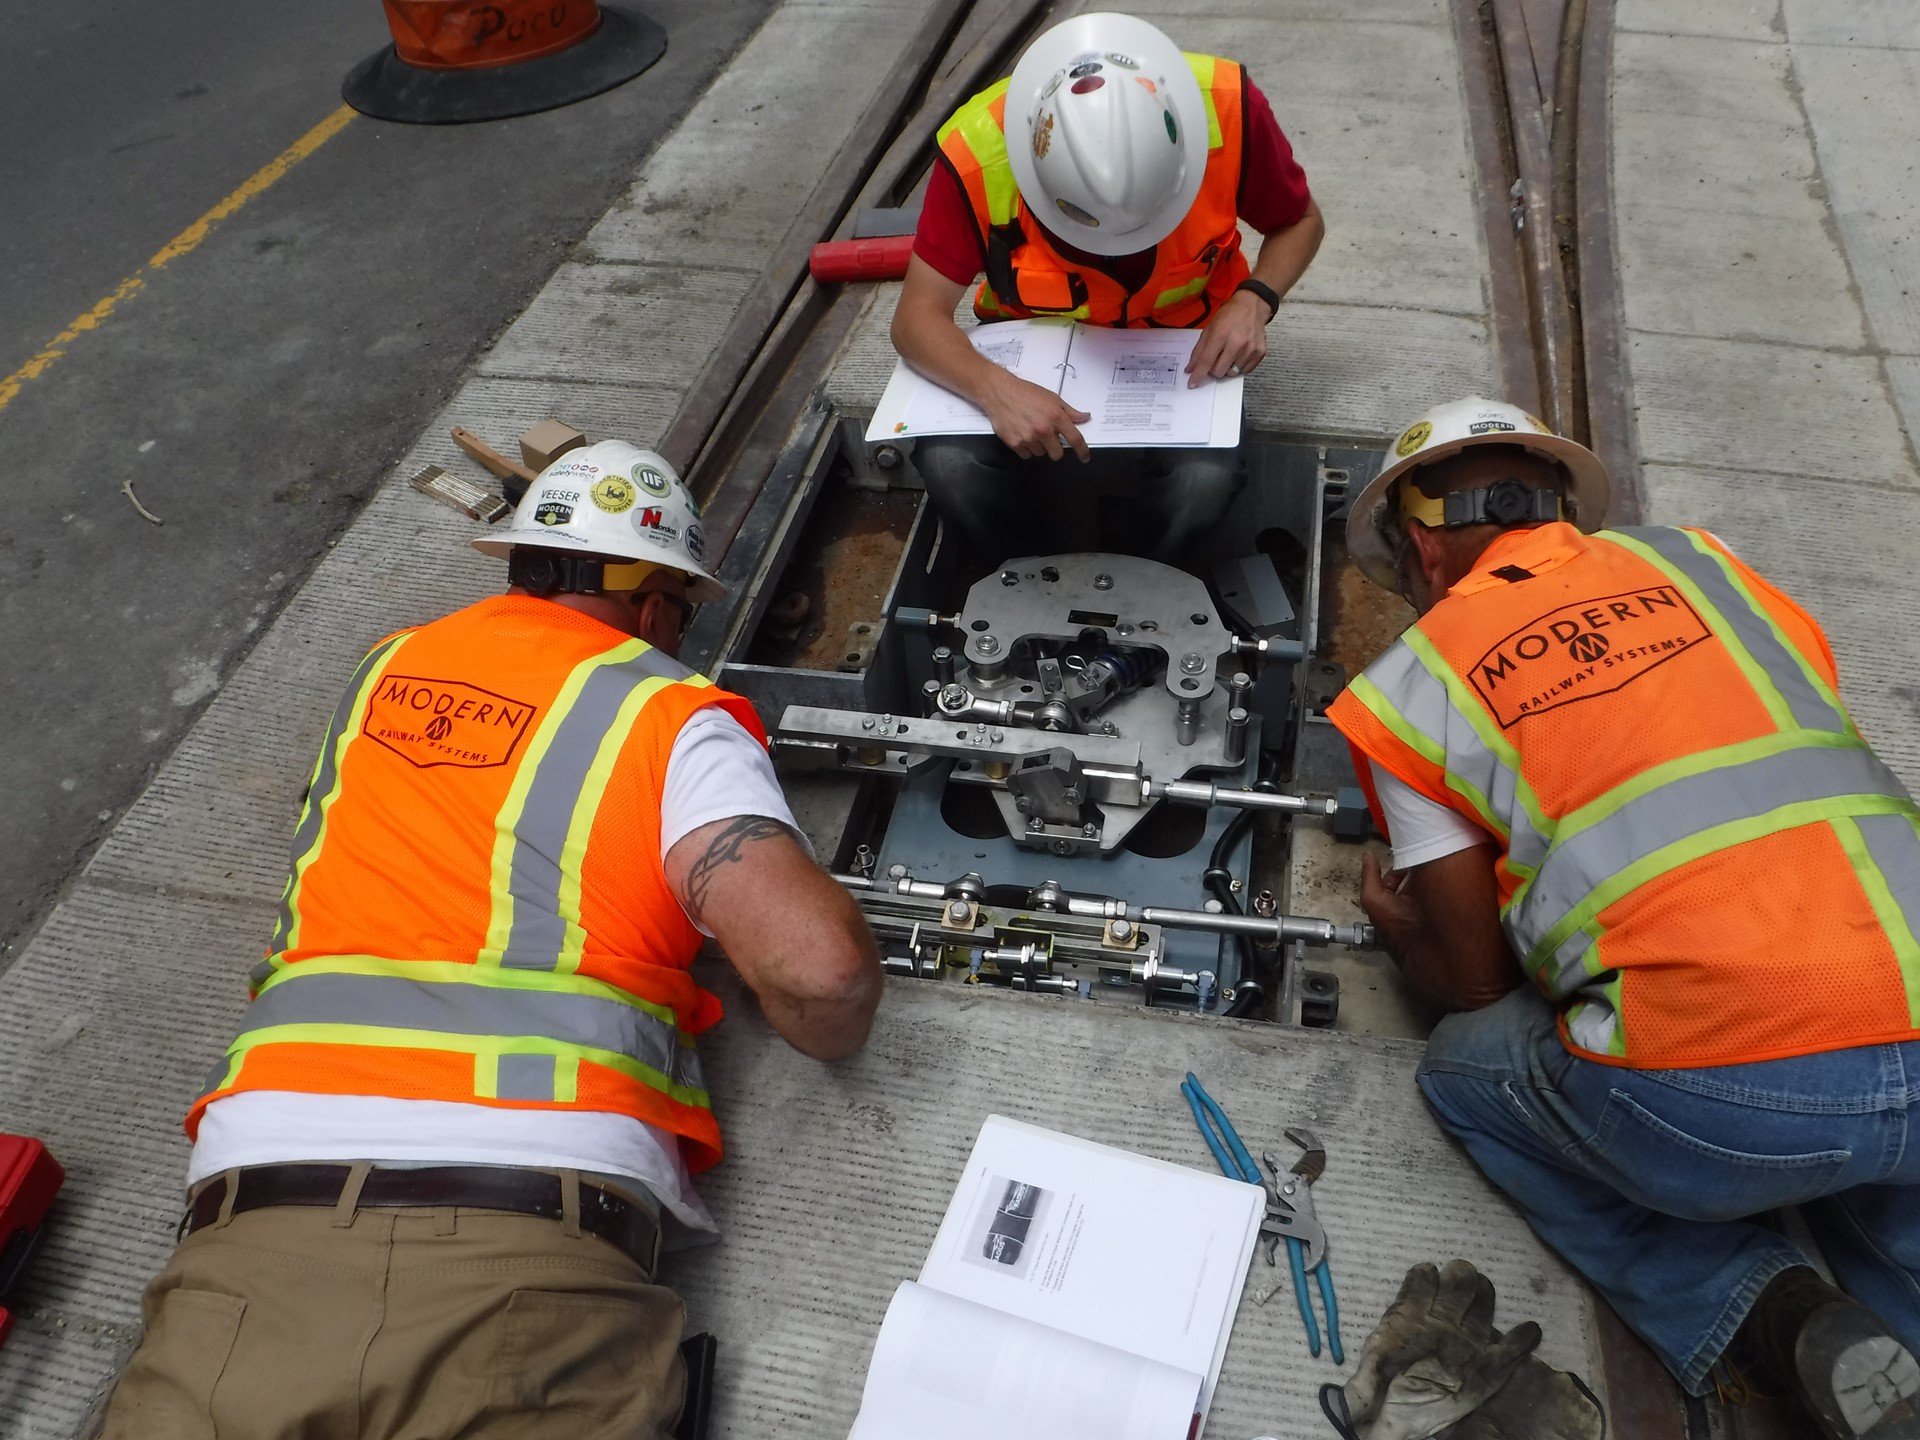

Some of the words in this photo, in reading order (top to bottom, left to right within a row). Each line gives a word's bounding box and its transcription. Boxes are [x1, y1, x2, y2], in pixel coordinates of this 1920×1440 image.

[537, 503, 573, 515] MODERN
[541, 489, 581, 502] VEESER
[613, 498, 632, 512] DRIVER
[640, 508, 677, 535] Nordco
[1481, 589, 1678, 691] MODERN
[1518, 666, 1596, 713] RAILWAY
[1603, 636, 1688, 668] SYSTEMS
[381, 680, 523, 729] MODERN
[378, 729, 424, 744] RAILWAY
[427, 741, 488, 763] SYSTEMS
